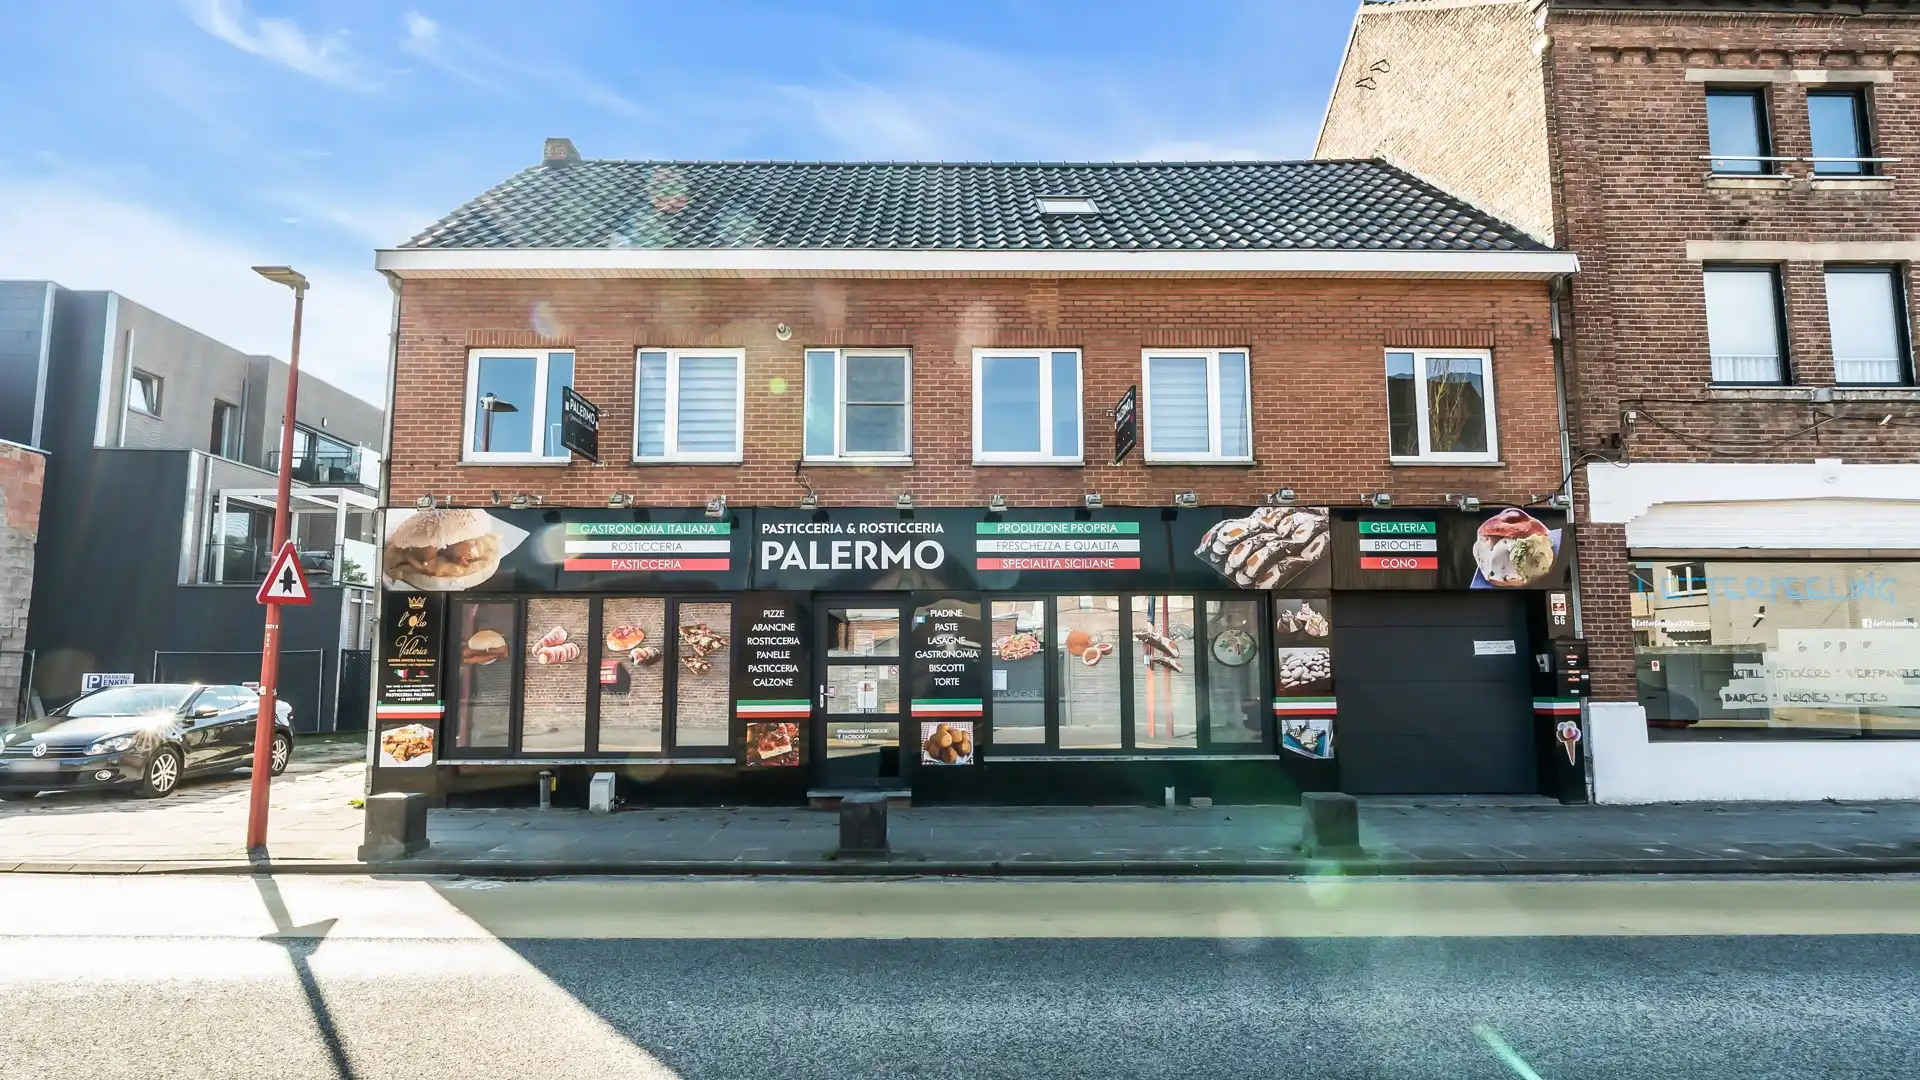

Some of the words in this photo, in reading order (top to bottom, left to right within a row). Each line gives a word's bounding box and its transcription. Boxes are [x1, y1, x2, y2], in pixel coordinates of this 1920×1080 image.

[569, 399, 595, 425] PALERMO
[580, 524, 664, 534] GASTRONOMIA
[667, 524, 716, 534] ITALIANA
[762, 523, 843, 534] PASTICCERIA
[846, 523, 856, 534] &
[859, 523, 944, 534] ROSTICCERIA
[997, 524, 1068, 533] PRODUZIONE
[1071, 524, 1118, 533] PROPRIA
[1370, 523, 1427, 533] GELATERIA
[611, 542, 683, 551] ROSTICCERIA
[996, 541, 1061, 551] FRESCHEZZA
[1065, 542, 1071, 551] E
[1073, 541, 1120, 551] QUALITA
[1374, 541, 1422, 550] BRIOCHE
[761, 540, 945, 570] PALERMO
[611, 560, 682, 570] PASTICCERIA
[1002, 559, 1061, 569] SPECIALITA
[1064, 559, 1115, 569] SICILIANE
[1381, 558, 1418, 568] CONO
[763, 610, 785, 618] PIZZE
[930, 609, 963, 618] PIADINE
[1554, 615, 1566, 625] 66
[752, 623, 796, 632] ARANCINE
[935, 623, 958, 631] PASTE
[747, 637, 800, 646] ROSTICCERIA
[928, 636, 966, 645] LASAGNE
[756, 651, 791, 659] PANELLE
[915, 650, 979, 659] GASTRONOMIA
[748, 665, 799, 673] PASTICCERIA
[929, 664, 965, 673] BISCOTTI
[1776, 667, 1832, 679] STICKERS
[753, 678, 794, 687] CALZONE
[934, 677, 960, 686] TORTE
[1783, 692, 1830, 703] INSIGNES
